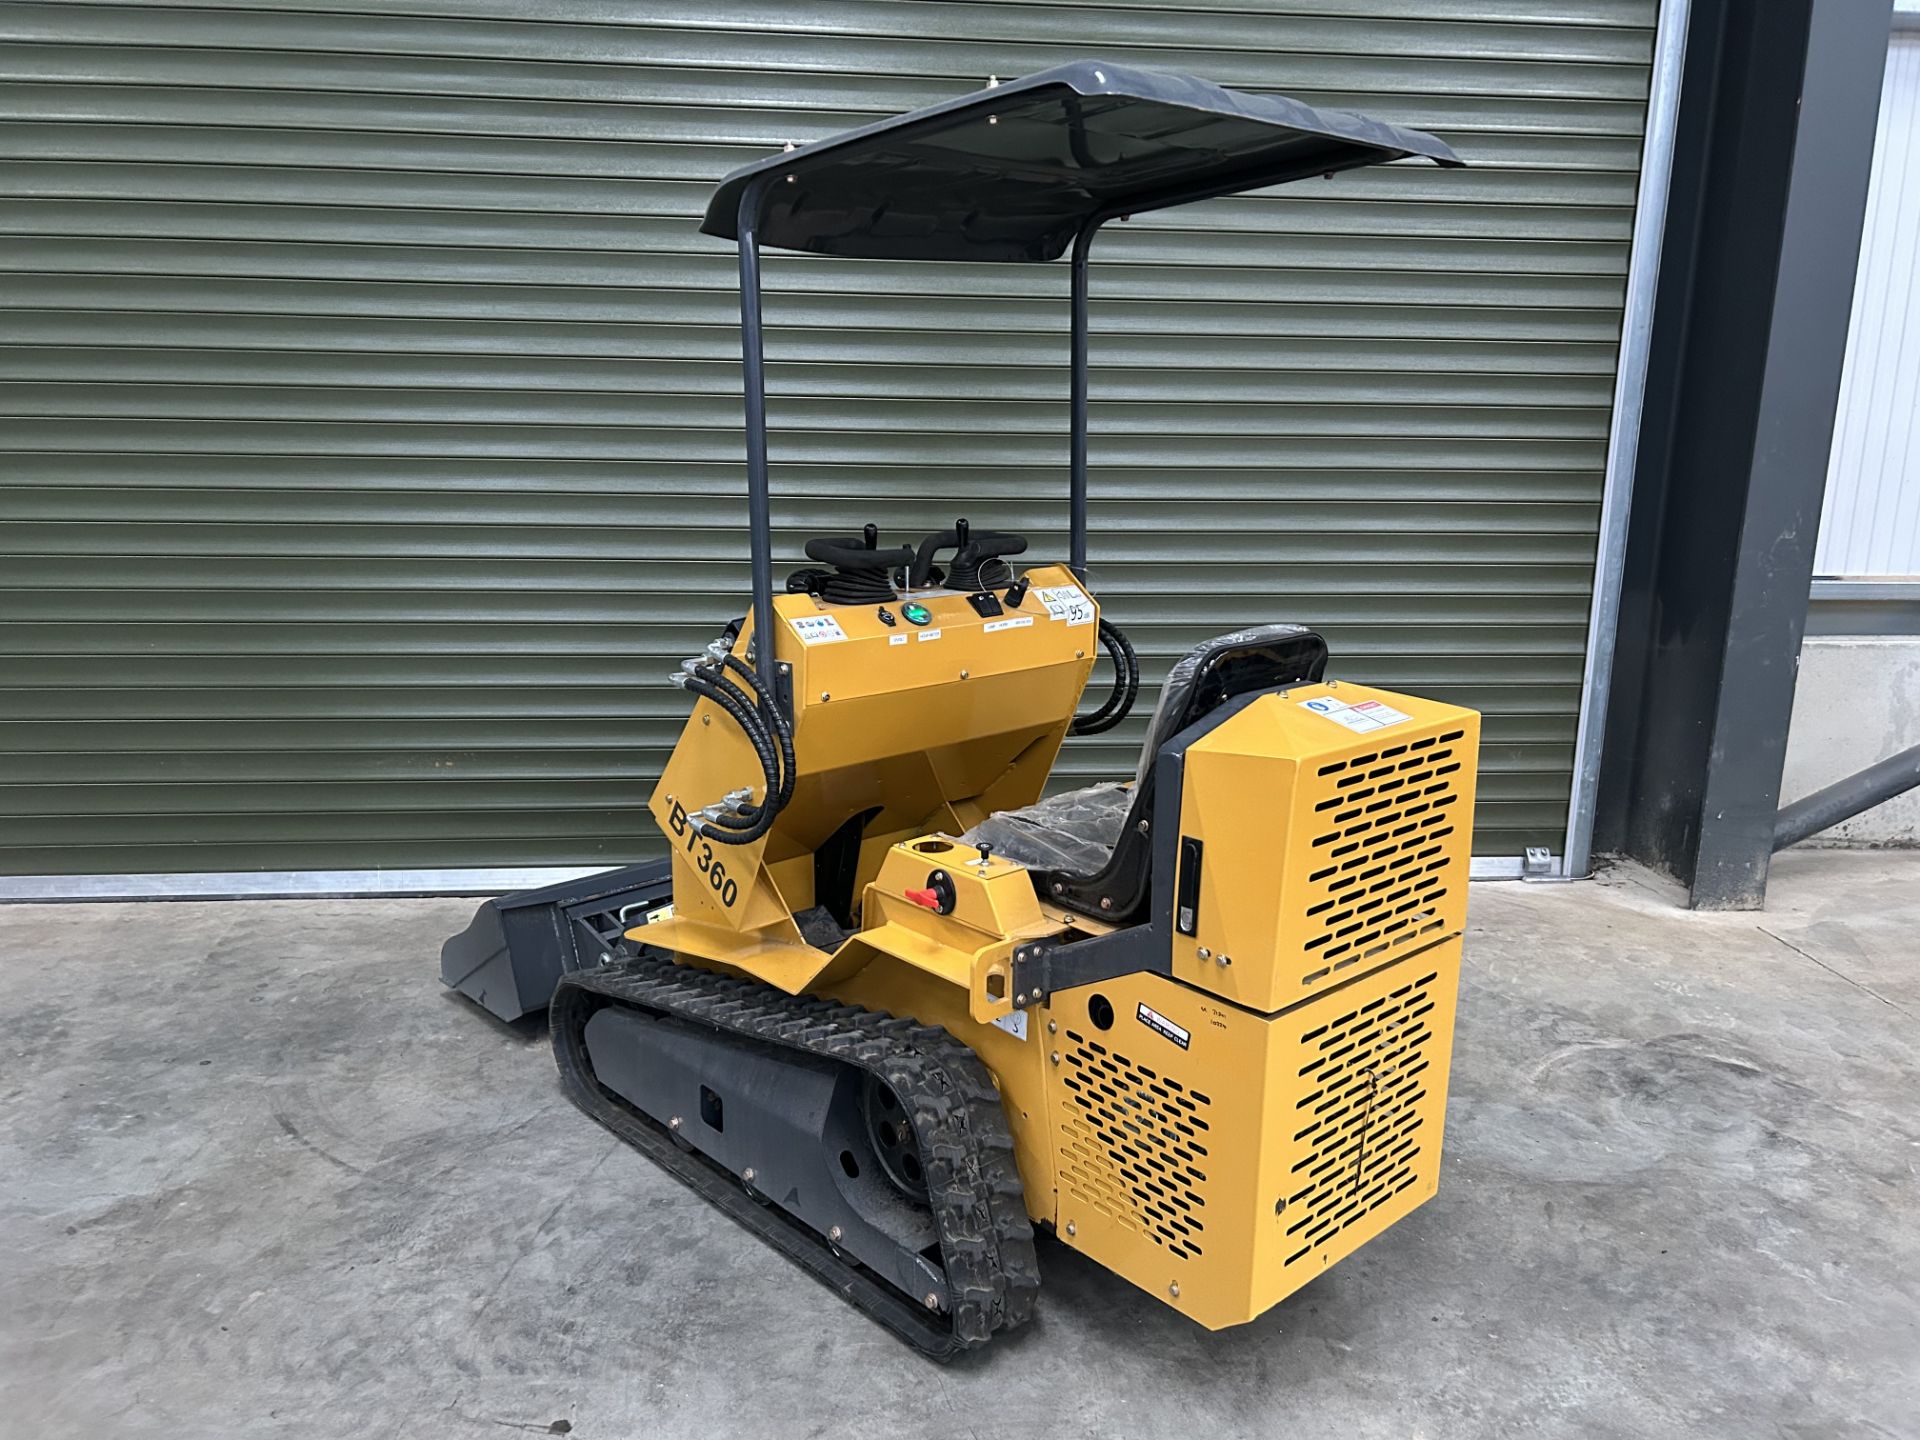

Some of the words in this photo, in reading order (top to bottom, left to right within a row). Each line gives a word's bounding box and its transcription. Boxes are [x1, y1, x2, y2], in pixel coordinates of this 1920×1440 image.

[1069, 604, 1083, 621] 95
[668, 800, 737, 908] BT360
[1173, 1035, 1187, 1048] CLEAR
